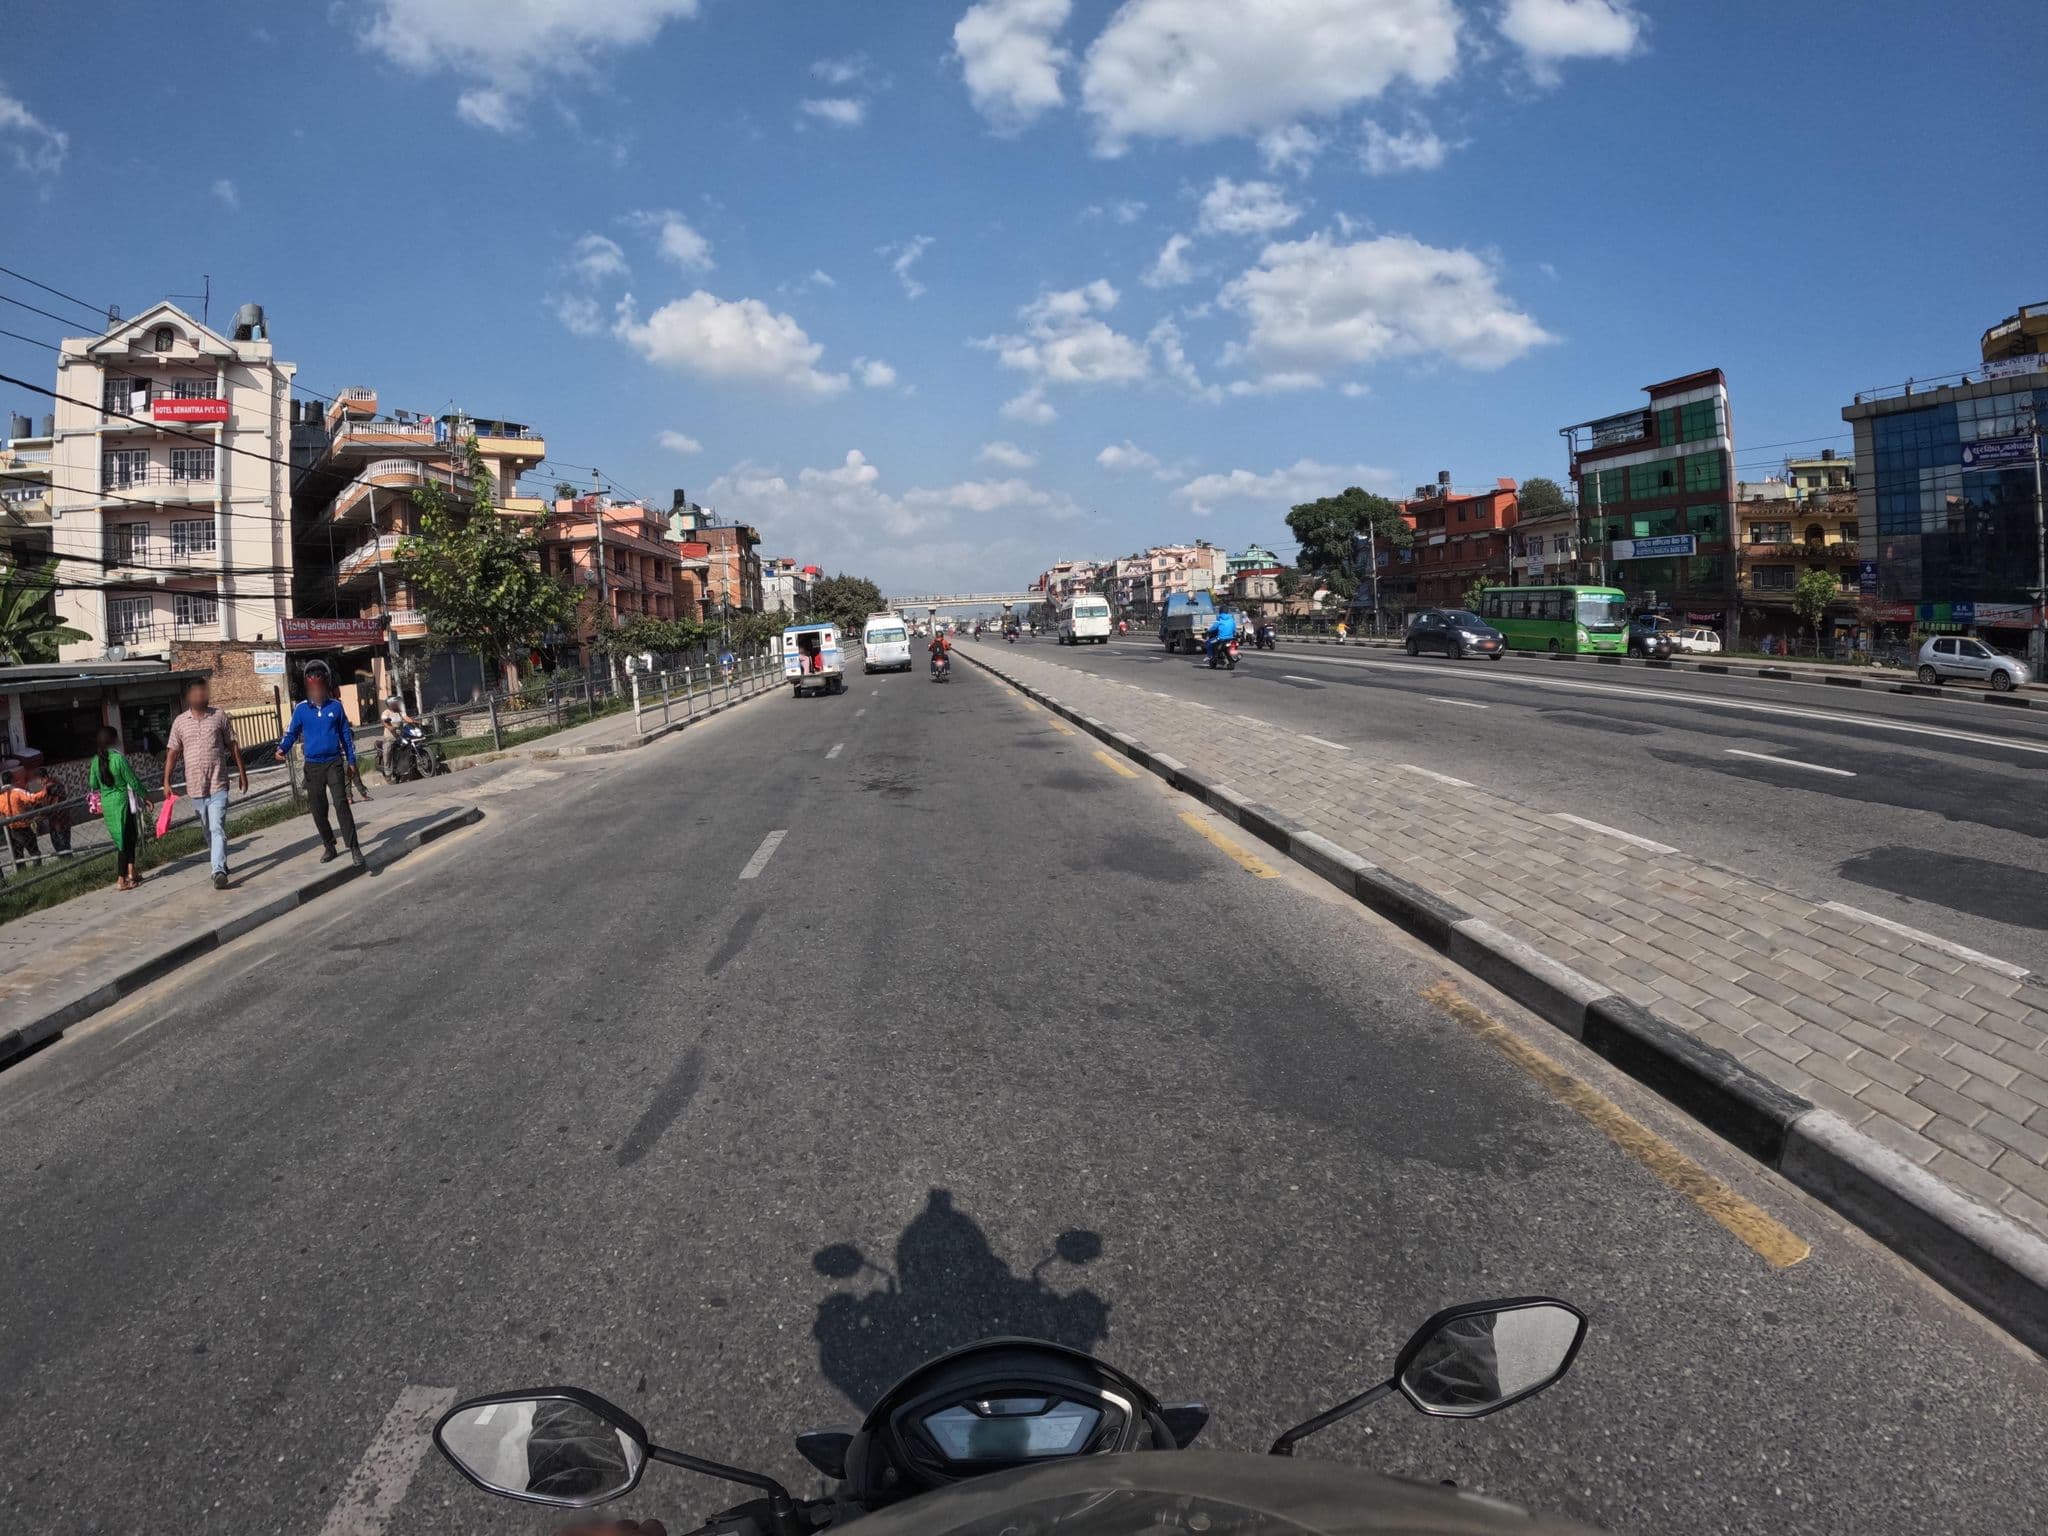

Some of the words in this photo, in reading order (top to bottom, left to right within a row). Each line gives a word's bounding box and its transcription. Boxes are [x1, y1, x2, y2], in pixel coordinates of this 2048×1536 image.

[155, 406, 172, 414] HOTEL
[204, 406, 216, 414] PVT.
[216, 406, 228, 414] LTD.
[285, 620, 309, 631] Hotel
[310, 619, 351, 630] Sewantika
[352, 619, 366, 630] Pvt.
